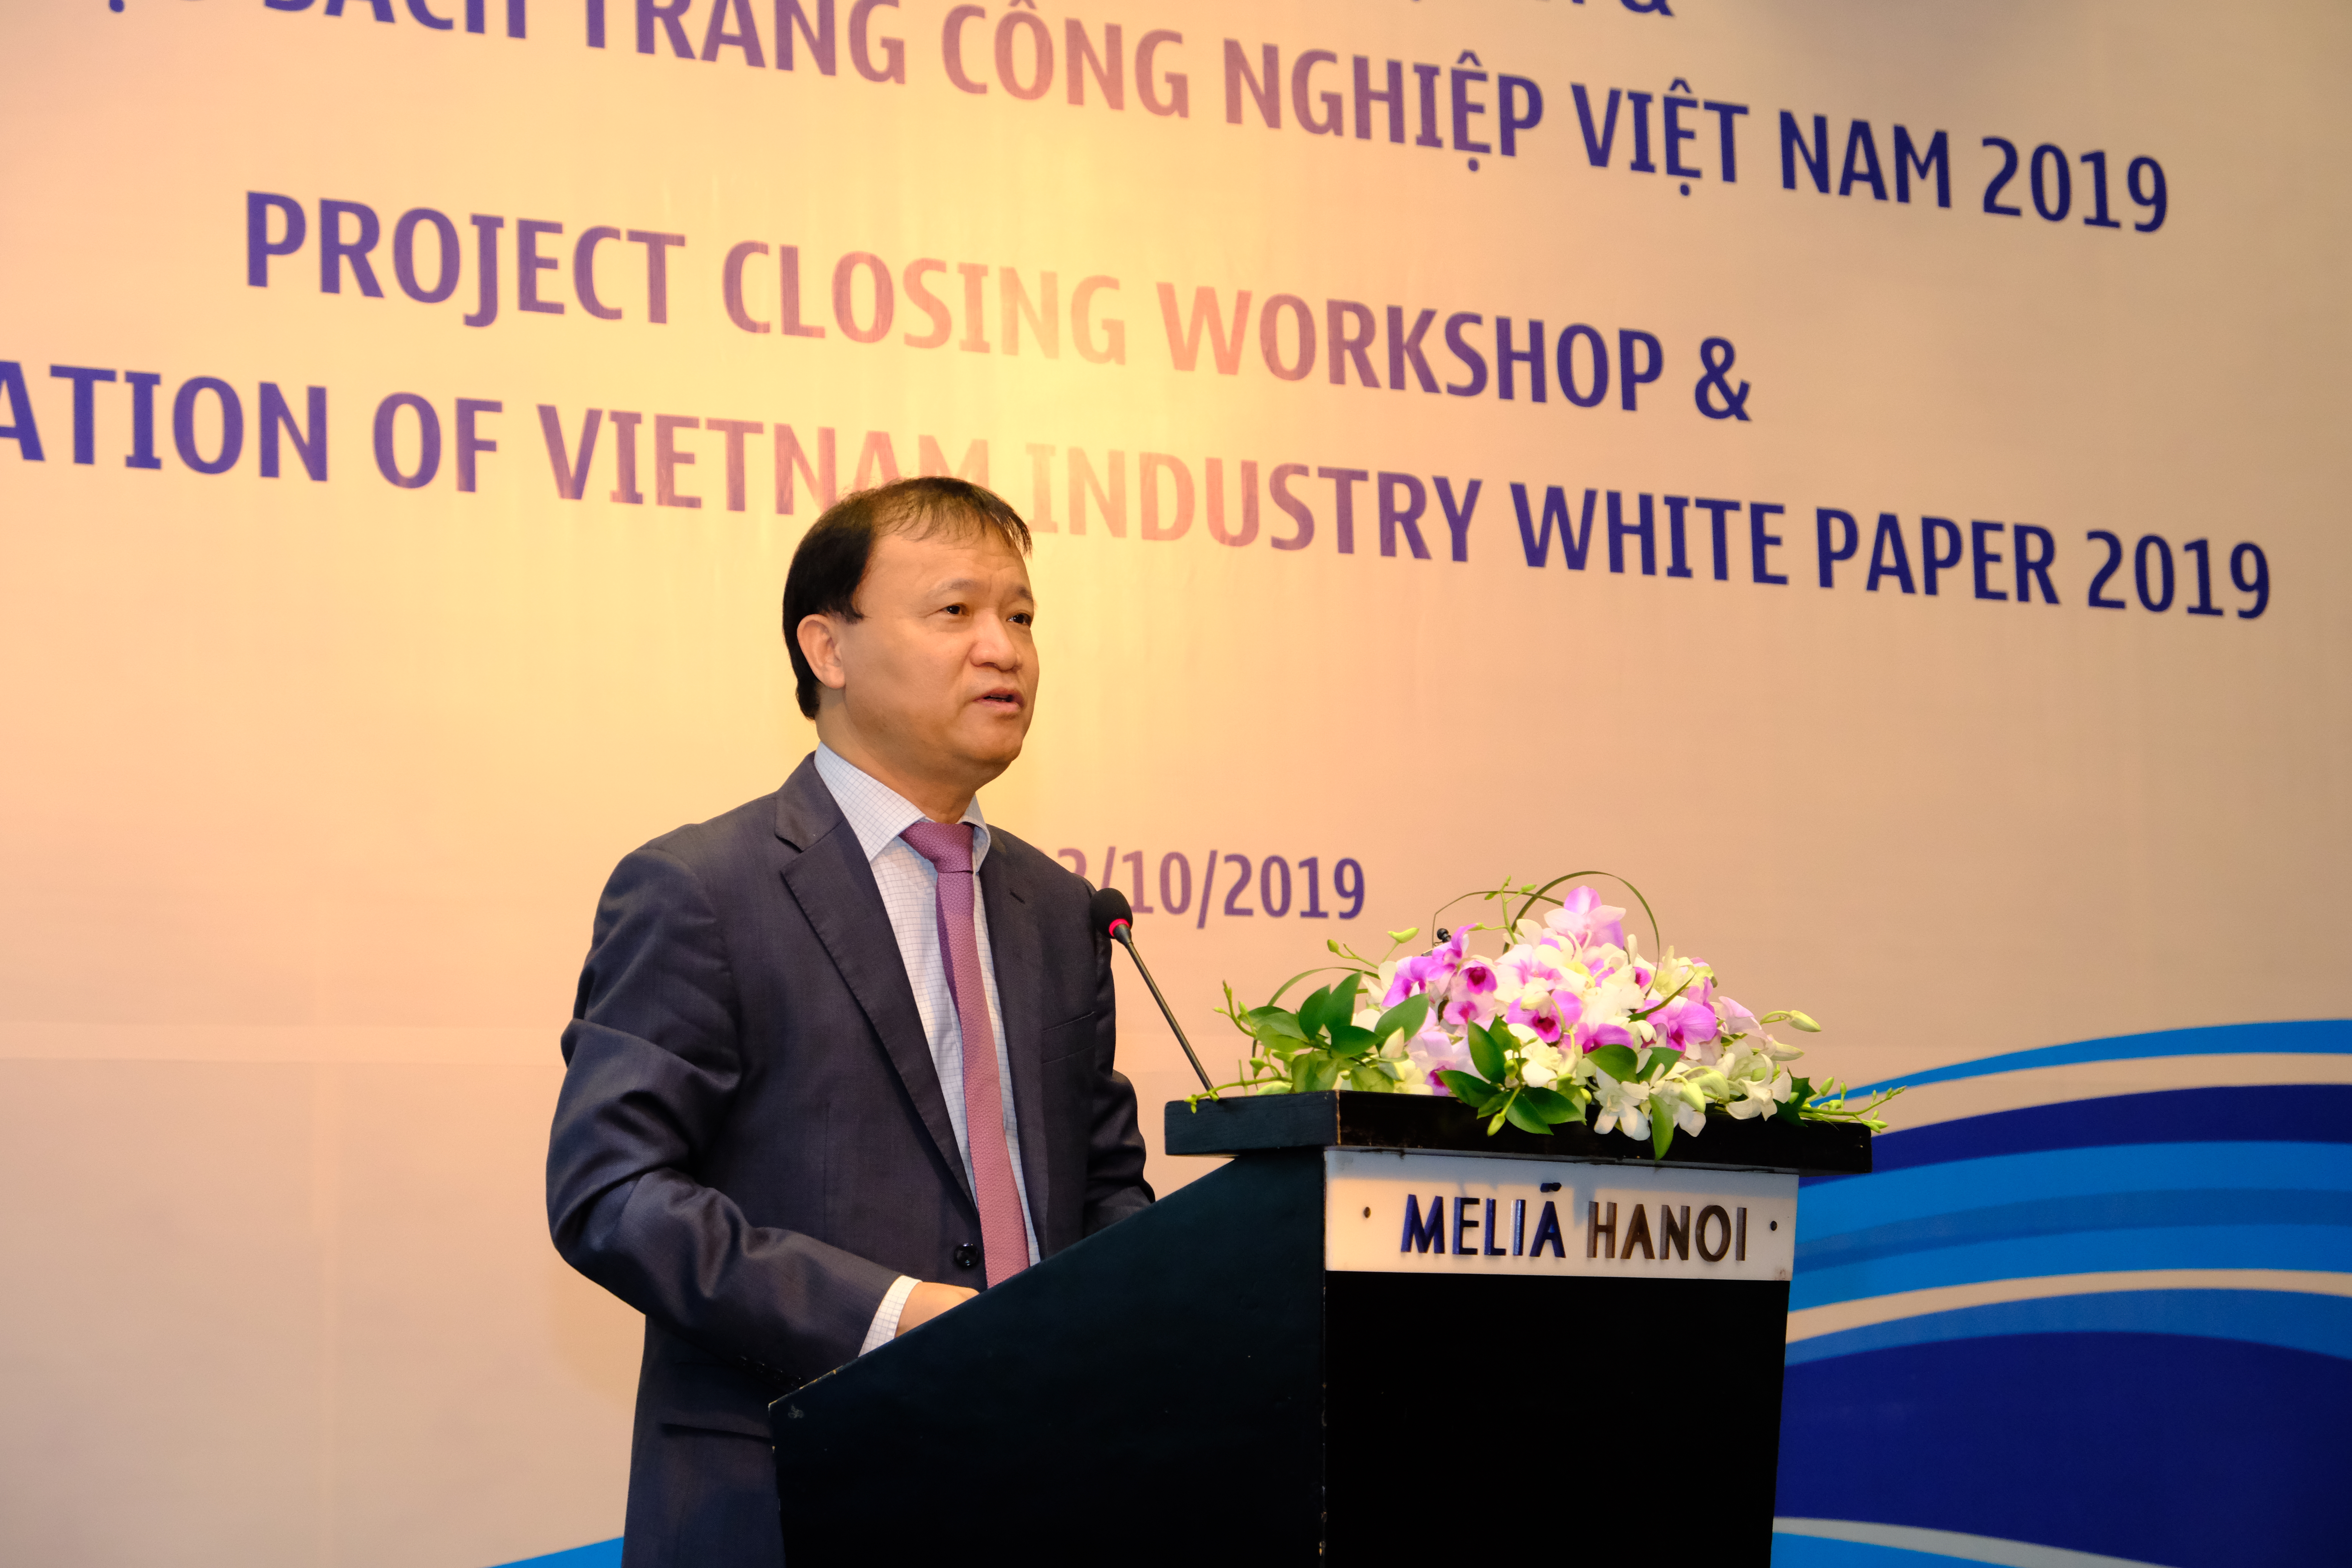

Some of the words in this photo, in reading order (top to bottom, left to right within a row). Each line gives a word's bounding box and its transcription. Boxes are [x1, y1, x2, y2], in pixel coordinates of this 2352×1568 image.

[942, 0, 1189, 118] CÔNG
[1223, 37, 1545, 173] NGHIỆP
[1570, 77, 1749, 197] VIỆT
[1779, 109, 1952, 210] NAM
[1981, 136, 2168, 234] 2019
[246, 190, 686, 329] PROJECT
[722, 240, 1125, 364] CLOSING
[1156, 282, 1664, 412] WORKSHOP
[1694, 336, 1752, 422] &
[372, 392, 504, 493] OF
[1026, 443, 1482, 563] INDUSTRY
[1510, 482, 1789, 586] WHITE
[1815, 507, 2061, 606] PAPER
[2086, 529, 2271, 620] 2019
[1035, 846, 1365, 929] /10/2019
[1586, 1201, 1747, 1262] HANOI
